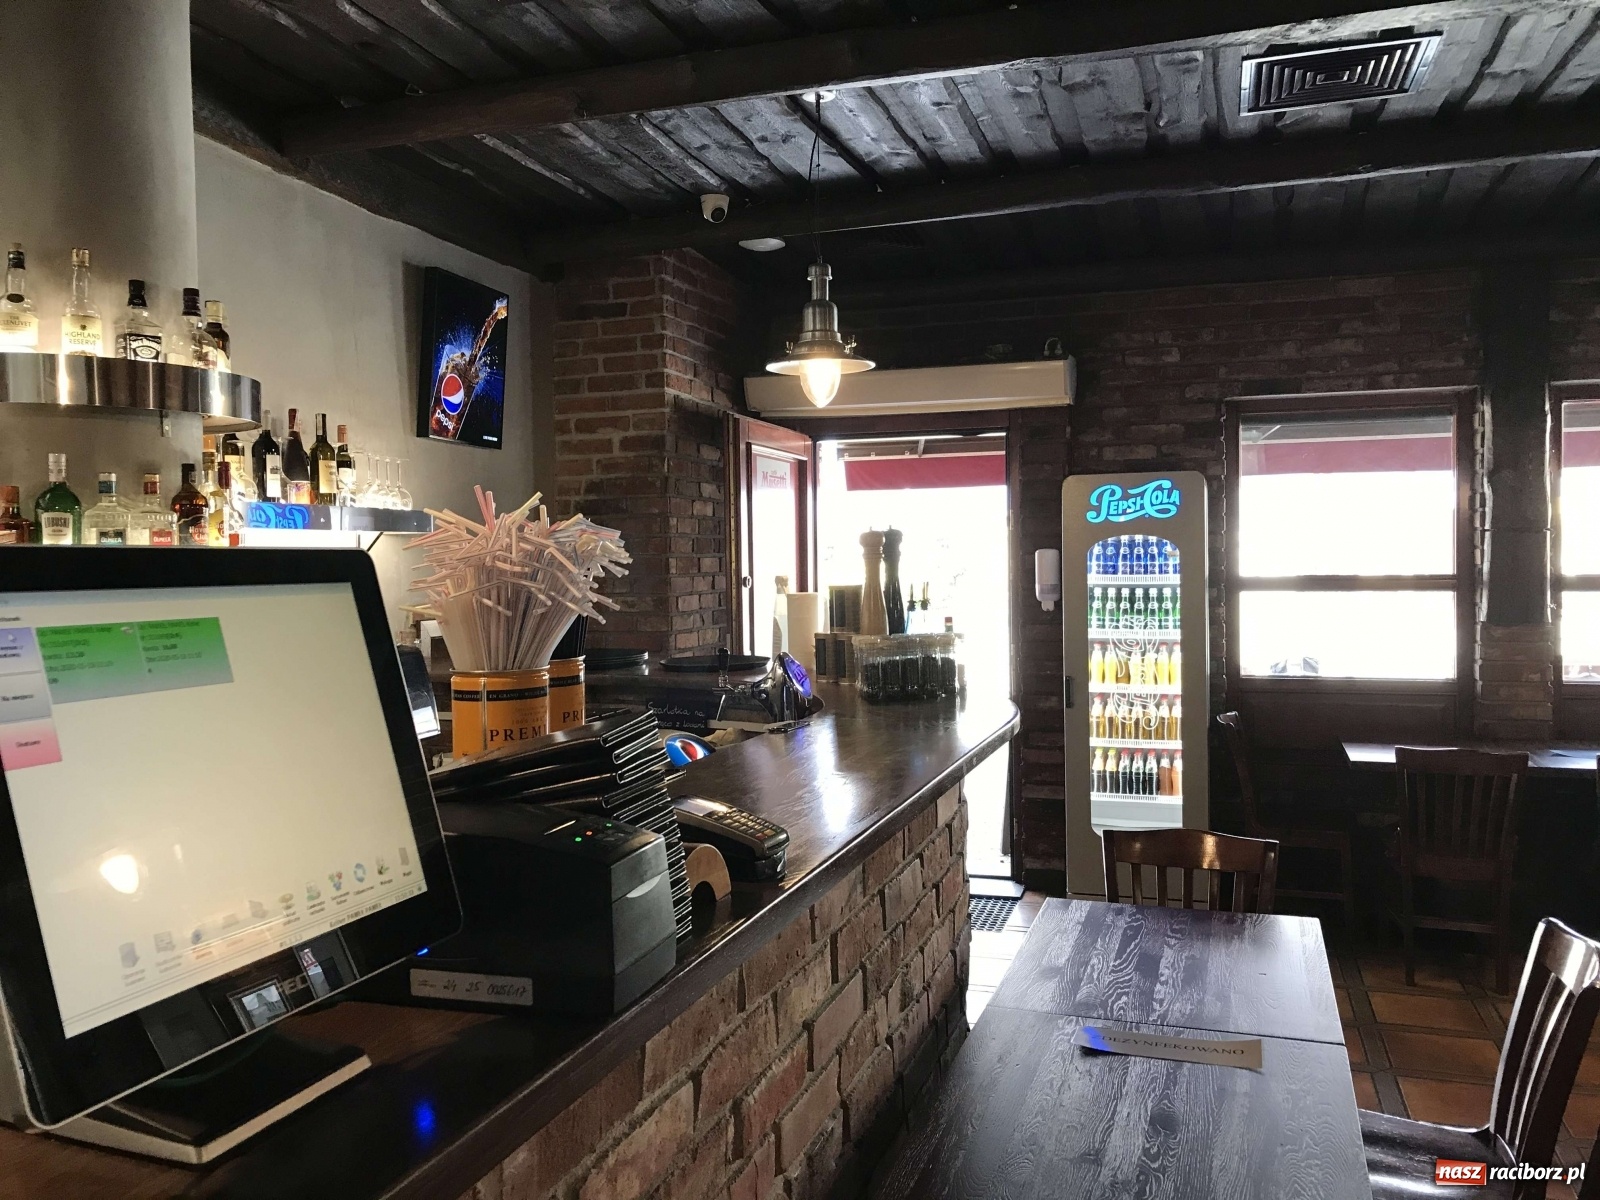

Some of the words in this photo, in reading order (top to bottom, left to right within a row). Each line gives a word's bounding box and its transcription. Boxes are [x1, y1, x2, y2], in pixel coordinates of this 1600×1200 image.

[65, 331, 101, 340] HIGHLAND
[69, 338, 97, 346] RESERVE
[436, 410, 455, 430] pepsi
